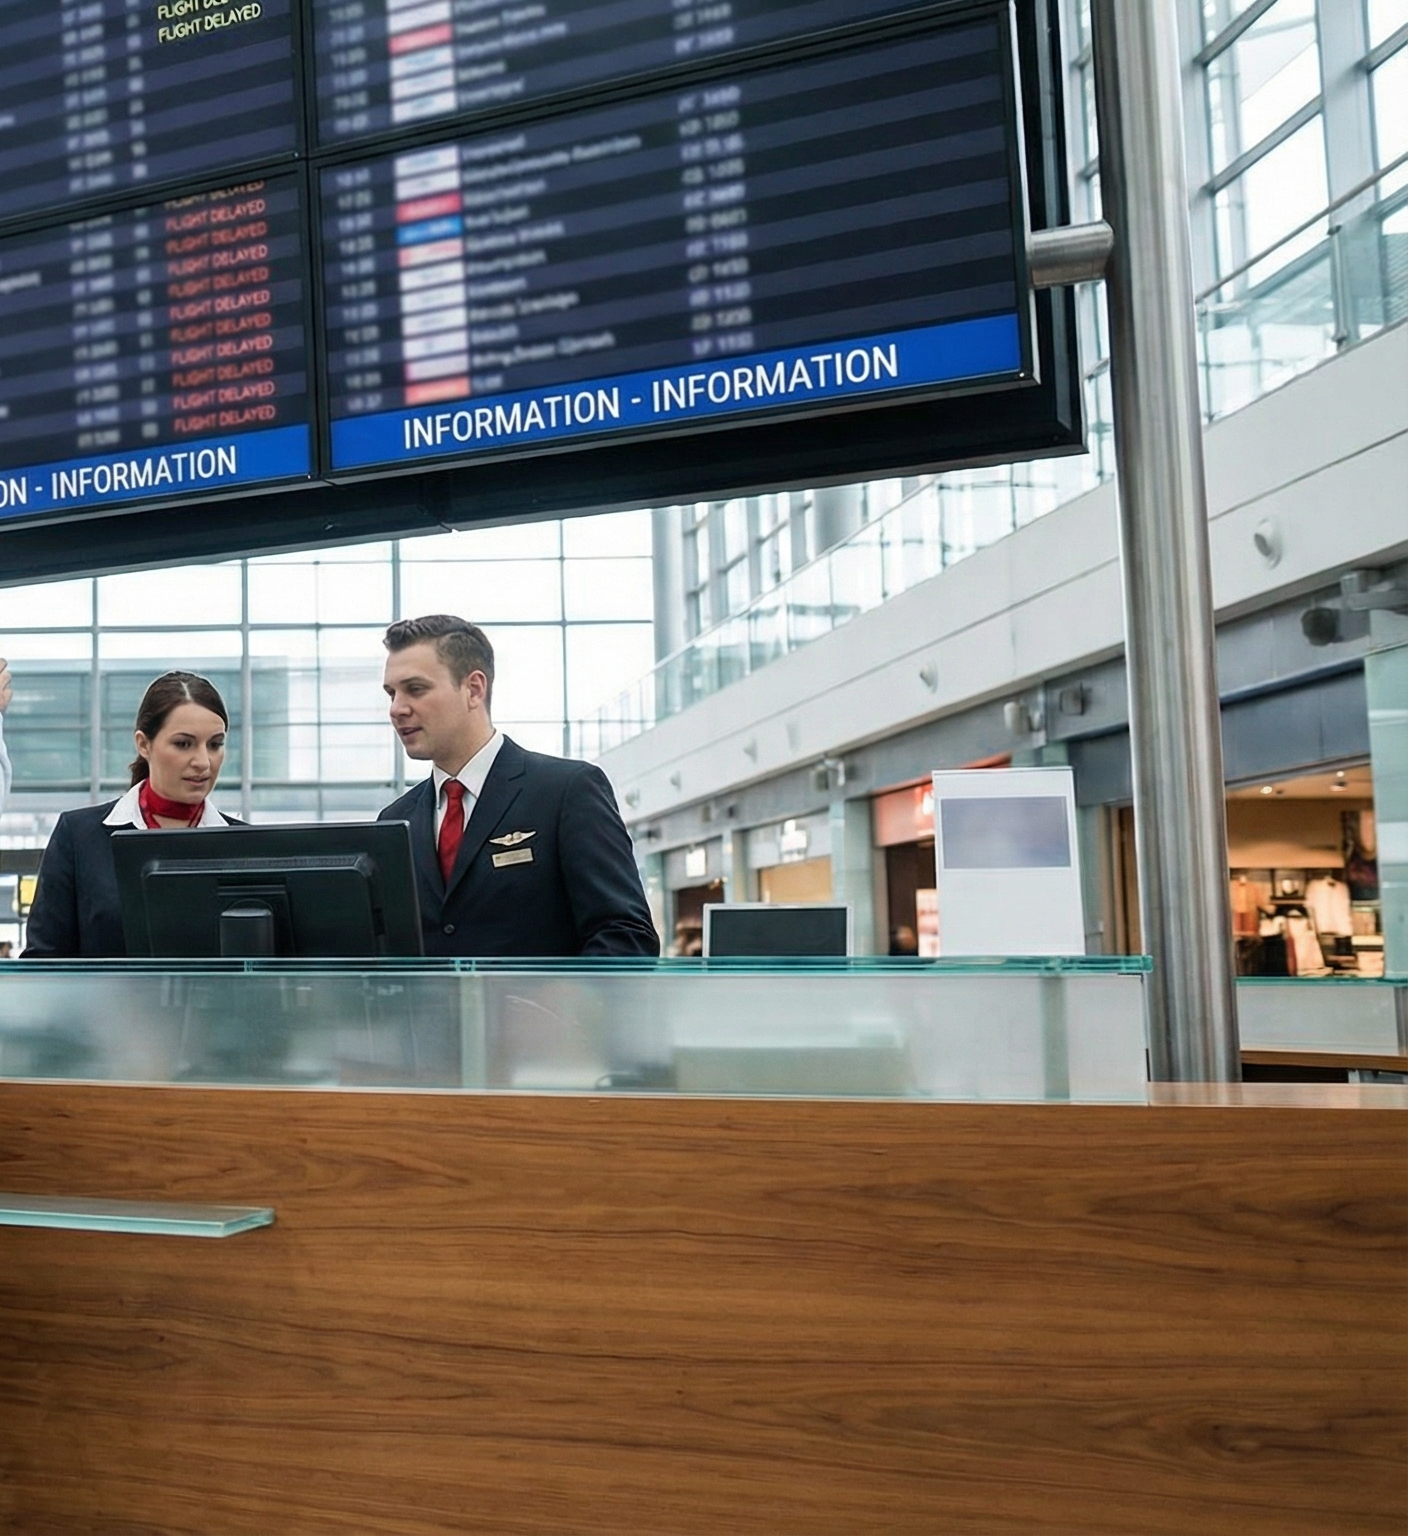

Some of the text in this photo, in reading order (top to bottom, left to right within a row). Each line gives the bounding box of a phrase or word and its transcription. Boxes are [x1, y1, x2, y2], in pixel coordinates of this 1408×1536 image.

[158, 3, 261, 43] FLIGHT DELAYED
[210, 198, 266, 222] DELAYED
[212, 244, 268, 268] DELAYED
[214, 290, 270, 313] DELAYED
[216, 334, 273, 357] DELAYED
[218, 381, 275, 403] DELAYED
[404, 388, 620, 449] INFORMATION
[652, 343, 899, 413] INFORMATION
[51, 445, 237, 500] INFORMATION
